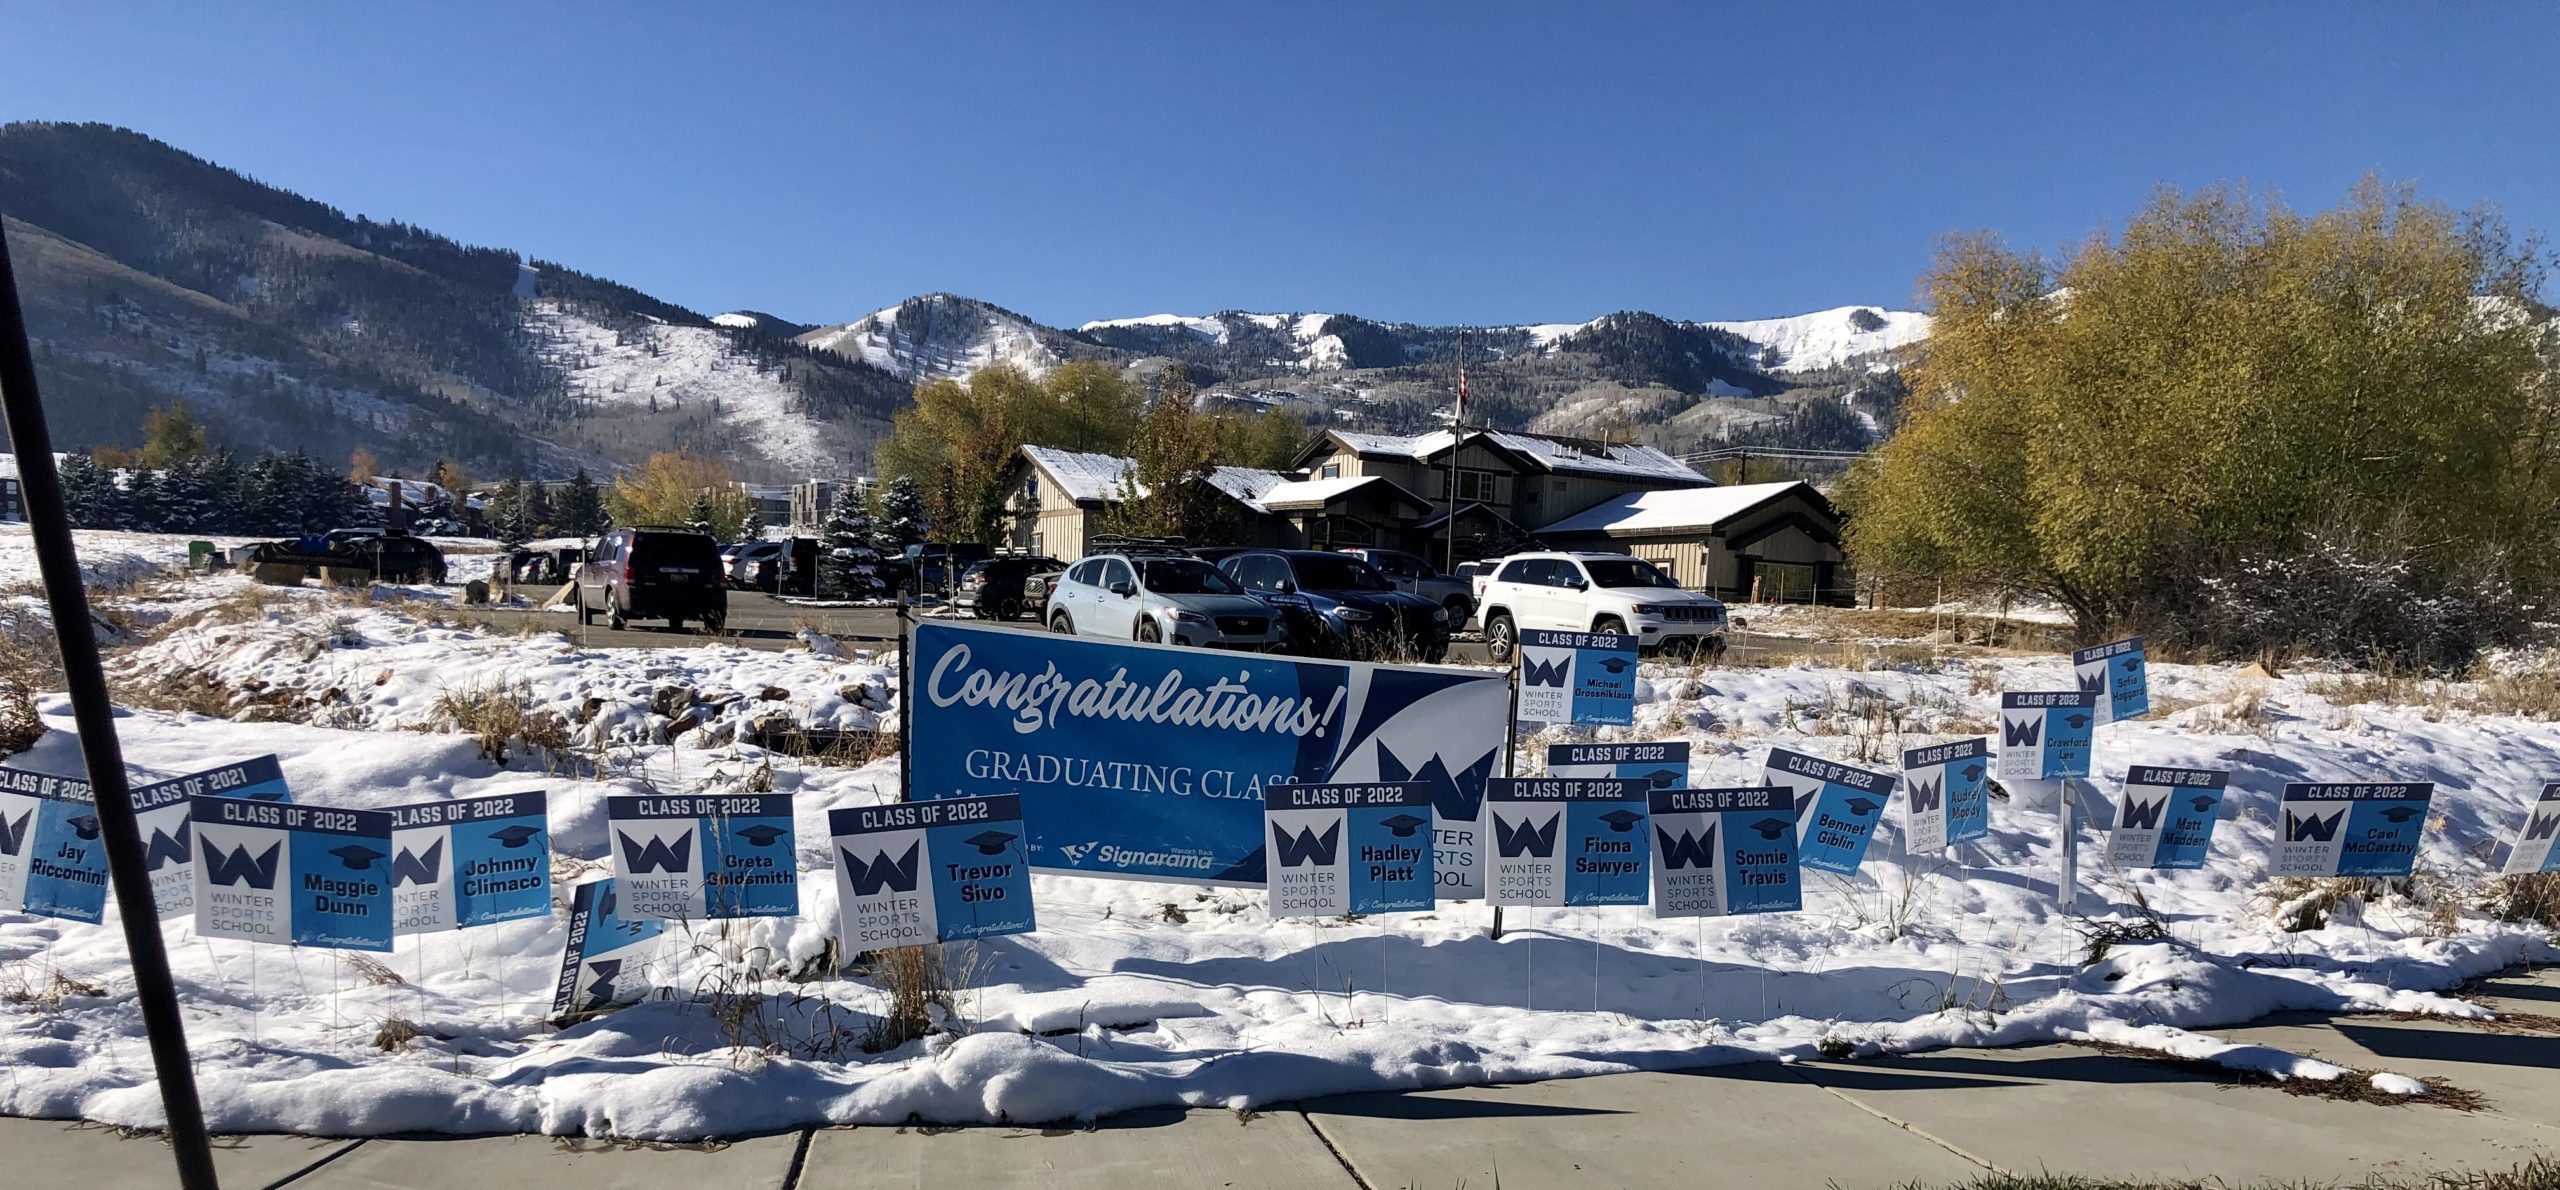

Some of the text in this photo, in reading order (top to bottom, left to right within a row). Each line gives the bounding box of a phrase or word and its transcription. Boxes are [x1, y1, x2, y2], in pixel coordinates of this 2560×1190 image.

[1539, 632, 1617, 648] CLASS OF 2022
[2084, 641, 2131, 661] CLASS OF 2022
[1587, 679, 1622, 688] Michael
[2117, 675, 2137, 688] Sofia
[927, 643, 1347, 739] Congratulations!
[1525, 691, 1563, 699] WINTER
[1575, 688, 1632, 700] Grossniklaus
[1524, 700, 1562, 708] SPORTS
[2017, 695, 2080, 705] CLASS OF 2022
[1523, 708, 1561, 717] SCHOOL
[2048, 738, 2088, 748] Crawford
[1572, 747, 1664, 762] CLASS OF 2022
[1918, 743, 1973, 764] CLASS OF 2022
[965, 749, 1192, 797] GRADUATING
[1789, 756, 1873, 788] CLASS OF 2022
[2144, 770, 2211, 785] CLASS OF 2022
[41, 778, 58, 795] OF
[132, 768, 247, 809] CLASS OF 2021
[1514, 782, 1622, 798] CLASS OF 2022
[2308, 787, 2407, 798] CLASS OF 2022
[1293, 787, 1403, 805] CLASS OF 2022
[1672, 791, 1769, 809] CLASS OF 2022
[392, 799, 514, 826] CLASS OF 2022
[639, 798, 761, 815] CLASS OF 2022
[224, 803, 357, 831] CLASS OF 2022
[862, 802, 988, 828] CLASS OF 2022
[1818, 813, 1867, 836] Bennet
[2176, 817, 2202, 830] Matt
[1433, 829, 1473, 846] TER
[1818, 831, 1855, 850] Giblin
[2164, 833, 2205, 846] Madden
[2368, 829, 2399, 839] Cael
[58, 842, 86, 864] Jay
[1585, 837, 1632, 853] Fiona
[2344, 843, 2414, 854] McCarthy
[726, 855, 773, 868] Greta
[1098, 845, 1213, 869] Signarama
[1361, 845, 1422, 863] Hadley
[1433, 850, 1473, 867] RTS
[1736, 849, 1788, 865] Sonnie
[32, 858, 106, 885] Riccomini
[465, 857, 538, 876] Johnny
[947, 863, 1012, 882] Trevor
[1370, 866, 1414, 882] Platt
[1500, 864, 1552, 873] WINTER
[1576, 857, 1640, 877] Sawyer
[151, 870, 192, 887] WINTE
[631, 879, 689, 889] WINTER
[1282, 873, 1335, 883] WINTER
[1434, 871, 1472, 887] OOL
[1500, 877, 1552, 886] SPORTS
[1667, 875, 1714, 886] WINTER
[1739, 869, 1787, 885] Travis
[305, 873, 379, 898] Maggie
[463, 877, 542, 897] Climaco
[1282, 885, 1335, 896] SPORTS
[1500, 889, 1551, 898] SCHOOL
[1668, 887, 1714, 898] SPORTS
[211, 893, 274, 907] WINTER
[394, 890, 439, 904] INTER
[632, 891, 690, 901] SPORTS
[961, 885, 1006, 903] Sivo
[156, 897, 193, 913] SCHO
[315, 896, 368, 916] Dunn
[393, 902, 440, 916] ORTS
[633, 903, 690, 913] SCHOOL
[857, 899, 919, 914] WINTER
[1282, 898, 1336, 909] SCHOOL
[1669, 900, 1715, 911] SCHOOL
[211, 906, 274, 921] SPORTS
[859, 912, 920, 928] SPORTS
[211, 920, 274, 935] SCHOOL
[570, 910, 588, 945] 2022
[861, 927, 922, 942] SCHOOL
[566, 950, 580, 965] OF
